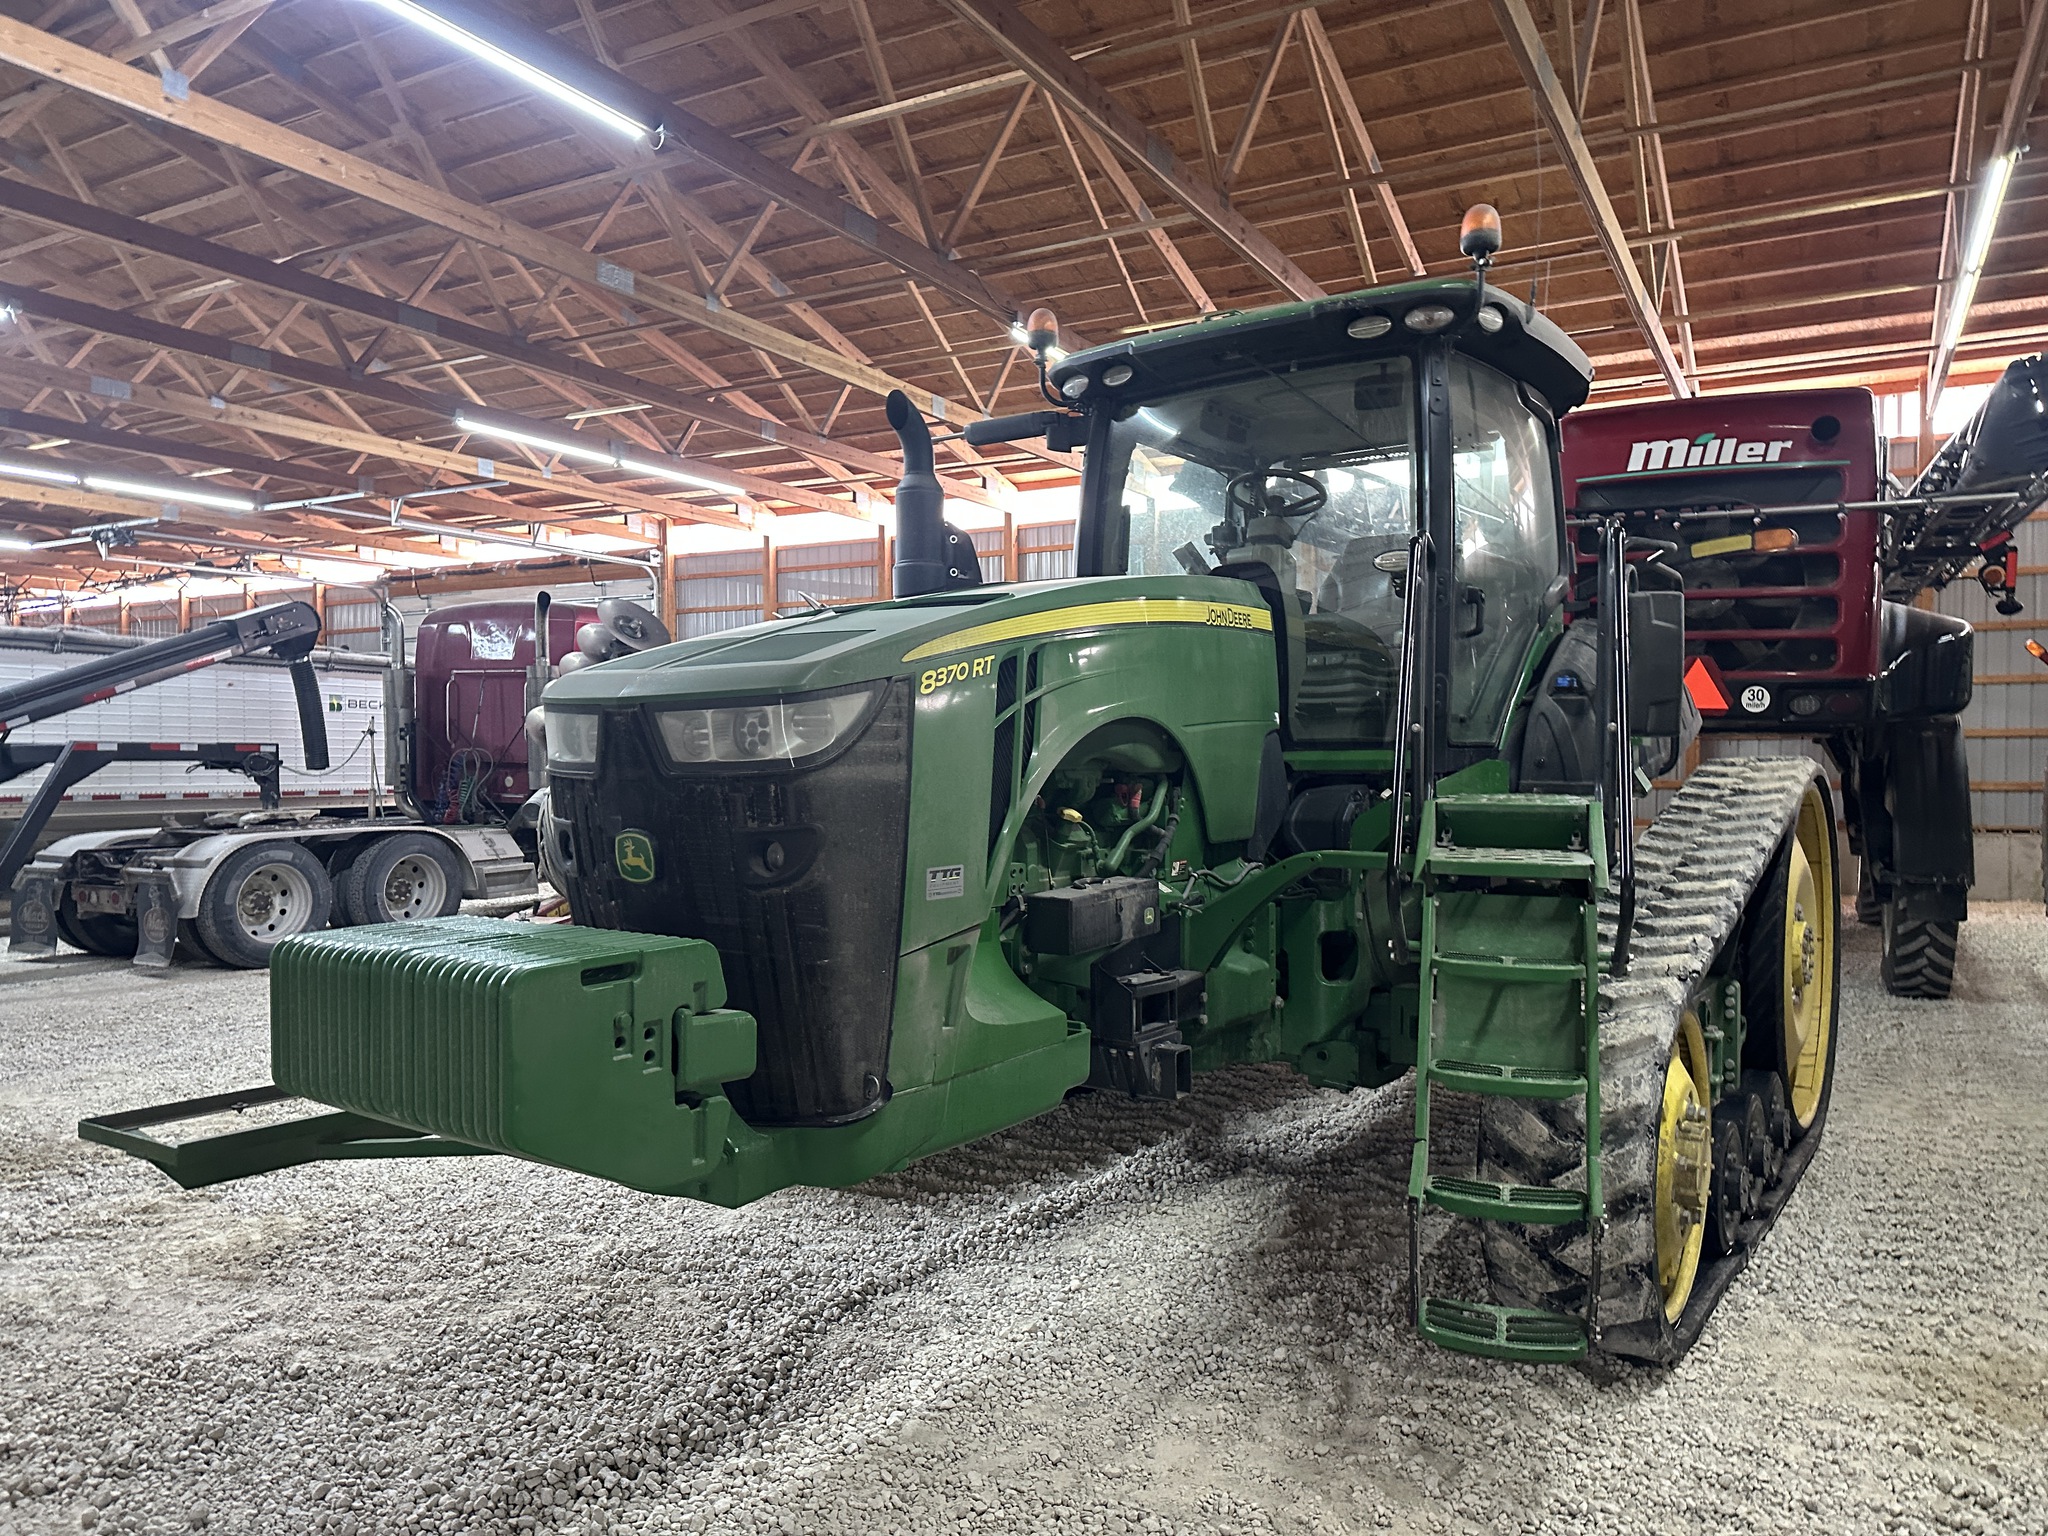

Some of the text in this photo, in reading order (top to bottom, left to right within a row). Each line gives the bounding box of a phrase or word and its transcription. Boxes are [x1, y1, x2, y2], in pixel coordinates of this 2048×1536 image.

[920, 654, 996, 695] 8370 RT
[1747, 688, 1765, 702] 30
[929, 867, 961, 882] TTG
